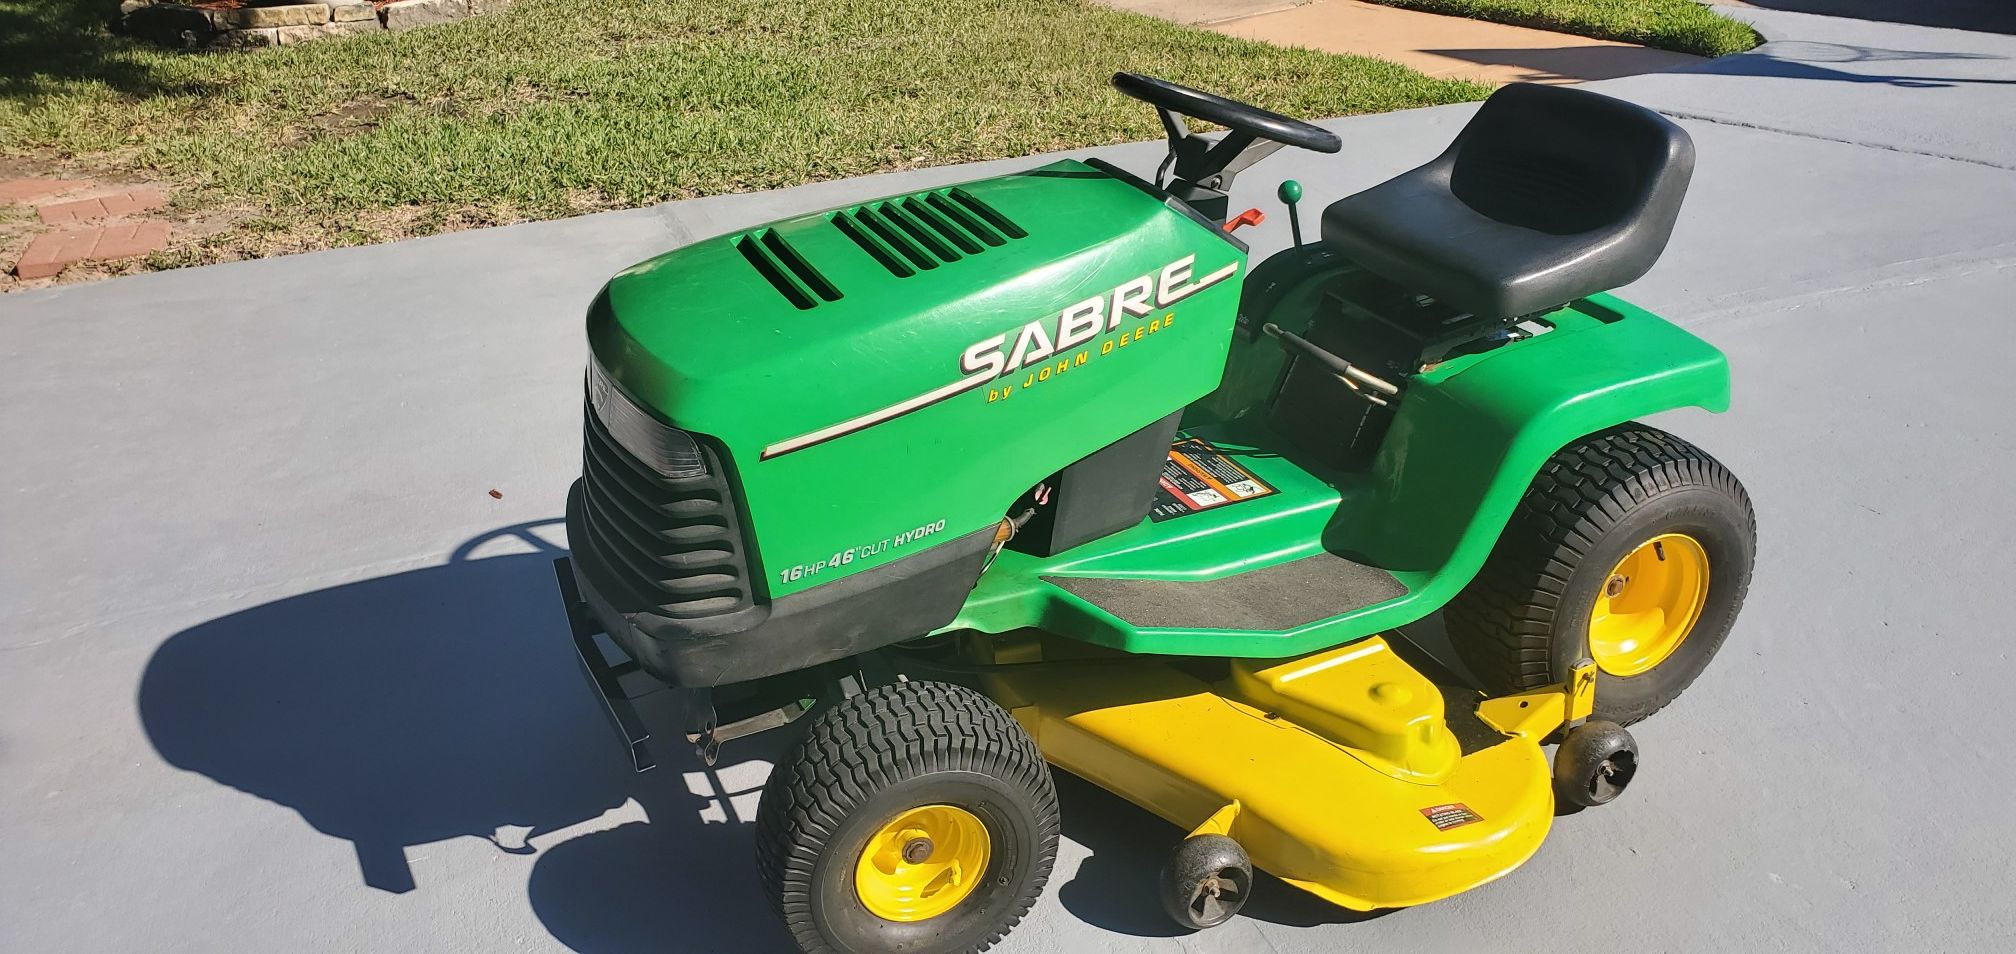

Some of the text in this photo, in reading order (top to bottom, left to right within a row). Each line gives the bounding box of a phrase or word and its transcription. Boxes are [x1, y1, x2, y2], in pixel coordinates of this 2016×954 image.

[959, 253, 1196, 382] SABRE
[987, 312, 1175, 403] by JOHN DEERE
[893, 519, 946, 548] HYDRO
